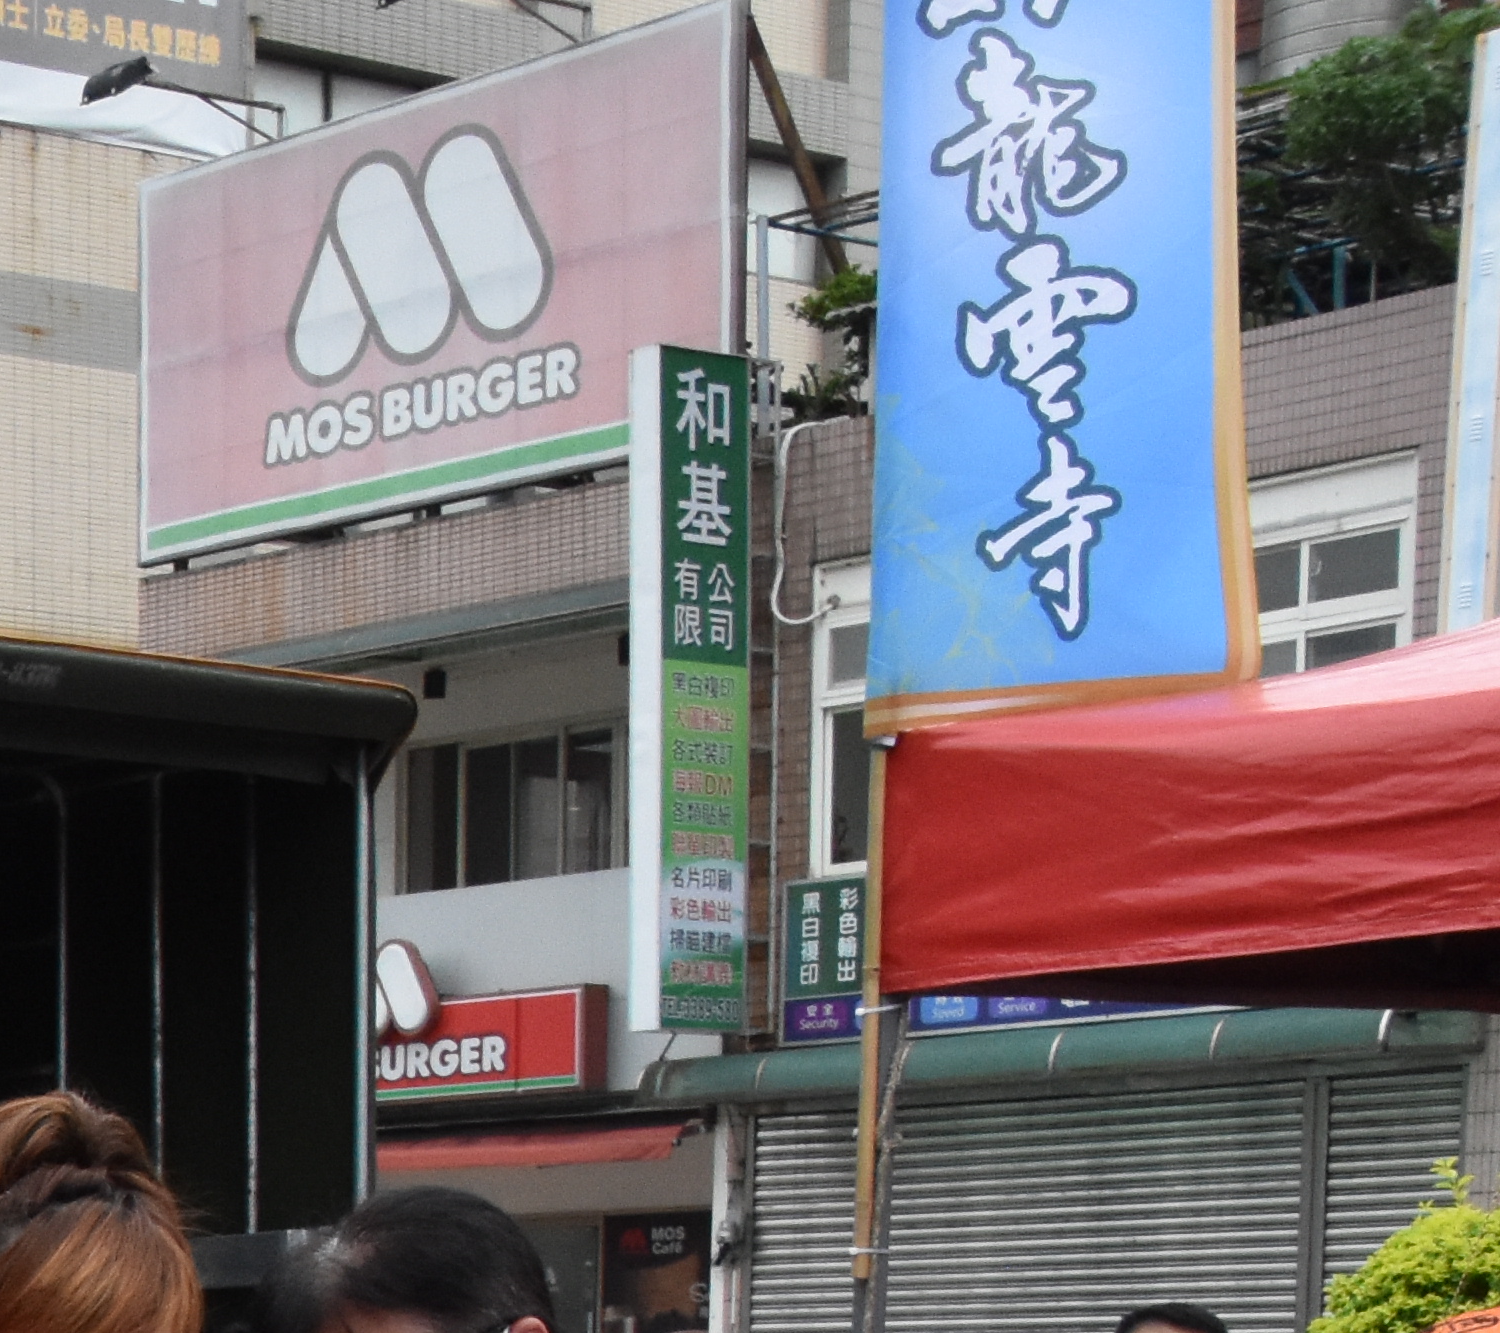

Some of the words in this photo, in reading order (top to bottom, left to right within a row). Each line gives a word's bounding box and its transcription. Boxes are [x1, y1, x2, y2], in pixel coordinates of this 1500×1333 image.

[920, 0, 1134, 637] 龍雲寺
[264, 395, 374, 465] MOS
[381, 346, 578, 438] BURGER
[675, 367, 733, 547] 和基
[376, 1035, 507, 1081] URGER
